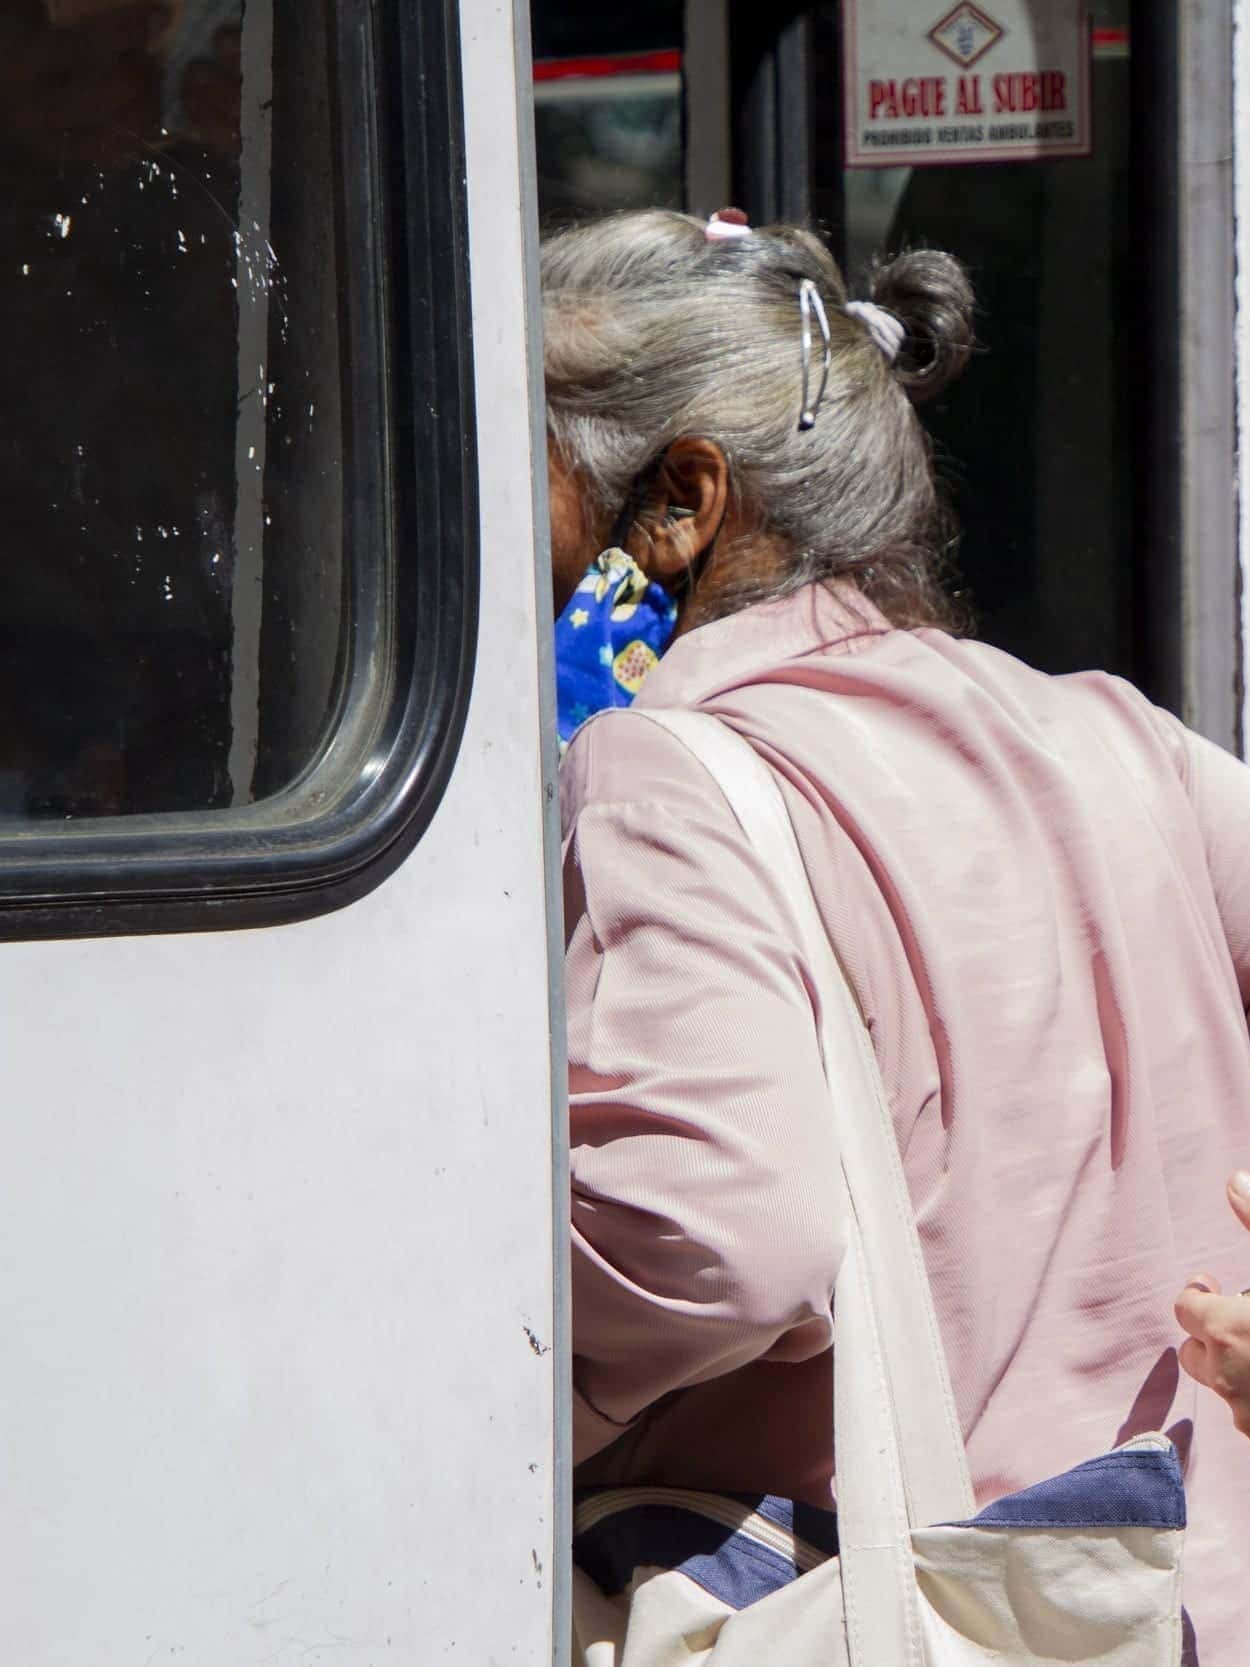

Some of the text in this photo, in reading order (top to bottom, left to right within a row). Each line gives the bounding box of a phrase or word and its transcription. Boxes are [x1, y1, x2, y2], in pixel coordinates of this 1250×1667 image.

[868, 70, 1067, 119] PAGUE AL SUBIR
[863, 128, 931, 145] PROHIBIDO
[937, 126, 984, 143] VENTAS
